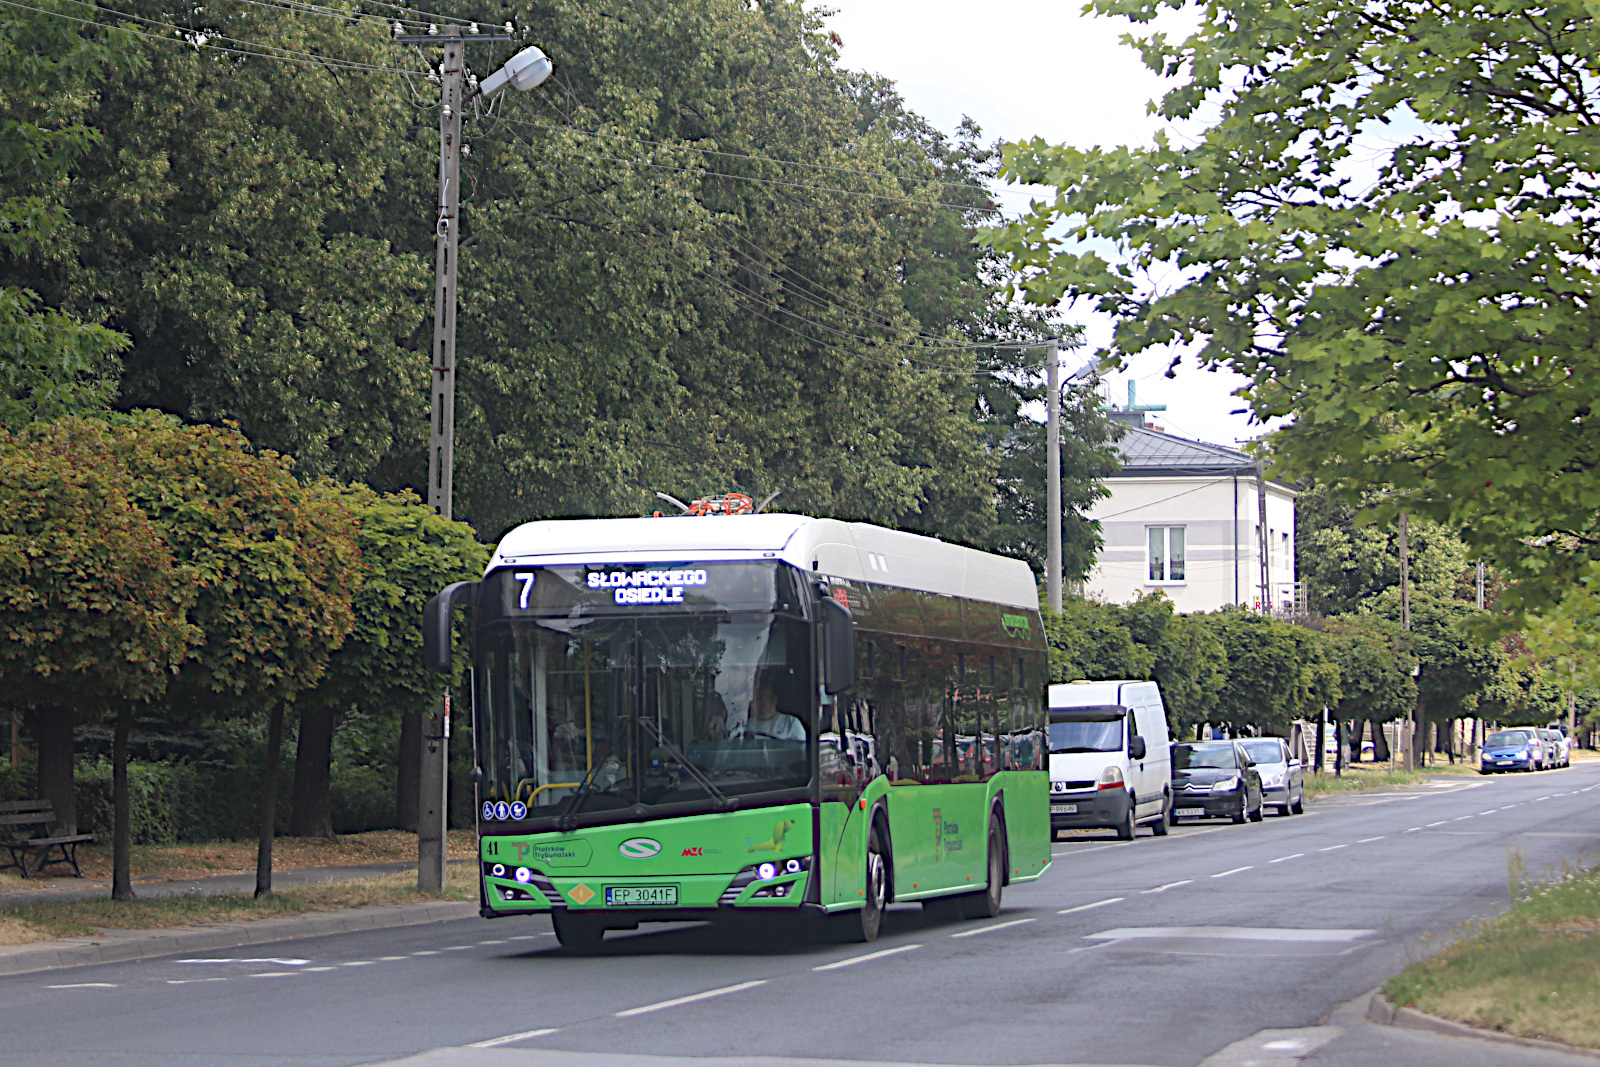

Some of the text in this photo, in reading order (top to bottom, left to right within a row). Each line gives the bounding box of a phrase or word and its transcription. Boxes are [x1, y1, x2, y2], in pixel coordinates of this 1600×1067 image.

[587, 570, 707, 587] SŁOWACKIEGO
[514, 572, 535, 609] 7
[615, 587, 683, 603] OSIEDLE
[487, 841, 499, 856] 41
[614, 888, 673, 902] EP 3041F
